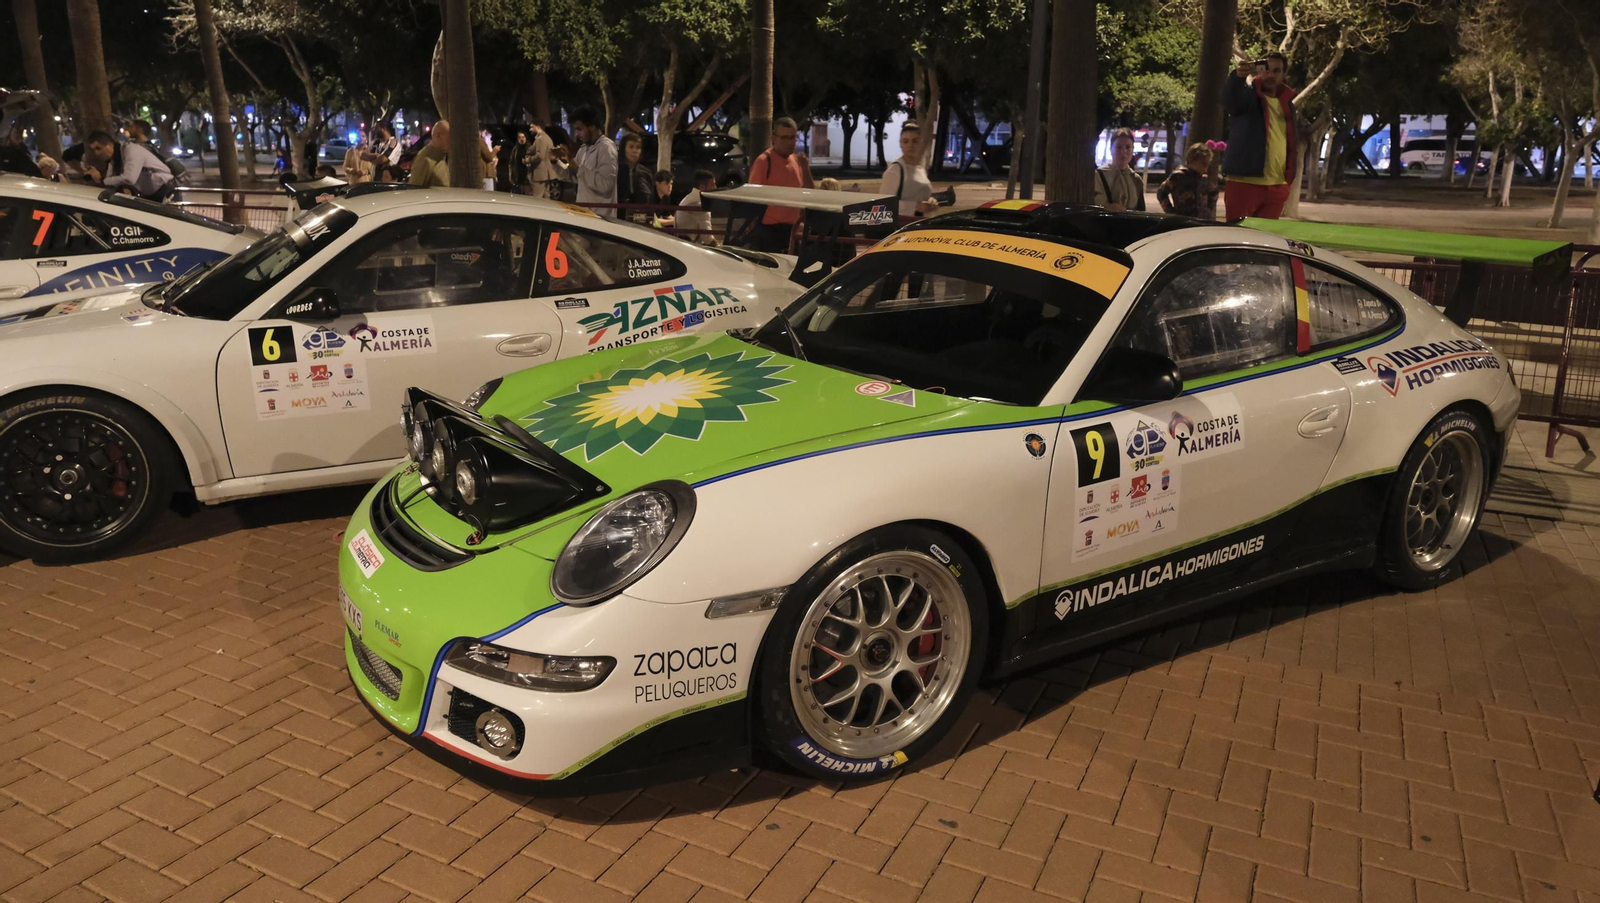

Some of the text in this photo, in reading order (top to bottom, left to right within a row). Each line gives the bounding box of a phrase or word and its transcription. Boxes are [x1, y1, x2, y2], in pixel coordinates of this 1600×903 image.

[849, 211, 893, 221] AZNAR
[32, 209, 55, 247] 7
[111, 226, 141, 237] O.Gil
[112, 237, 154, 245] C.Chamorro
[953, 238, 981, 247] CLUB
[980, 241, 997, 250] DE
[997, 244, 1049, 260] ALMERÍA
[545, 232, 569, 279] 6
[627, 258, 662, 269] J.A.Aznar
[628, 267, 663, 279] O.Roman
[286, 302, 314, 315] LOURDES
[578, 286, 741, 342] AZNAR
[678, 318, 686, 327] Y
[690, 305, 748, 323] LOGISTICA
[373, 335, 432, 352] ALMERÍA
[381, 327, 430, 338] COSTA DE
[262, 328, 281, 361] 6
[312, 350, 324, 360] 30
[1384, 339, 1489, 369] INDALICA
[1405, 356, 1500, 391] HORMIGONES
[863, 383, 885, 393] E
[6, 396, 86, 418] MICHELIN
[1197, 414, 1239, 433] COSTA DE
[1440, 419, 1477, 434] MICHELIN
[1190, 426, 1241, 453] ALMERÍA
[1085, 430, 1105, 480] 9
[1134, 458, 1146, 472] 30
[1073, 534, 1265, 612] INDALICA HORMIGONES
[375, 619, 400, 641] PLEMAR
[634, 642, 737, 680] zapata
[634, 672, 737, 704] PELUQUEROS
[797, 741, 877, 774] MICHELIN
